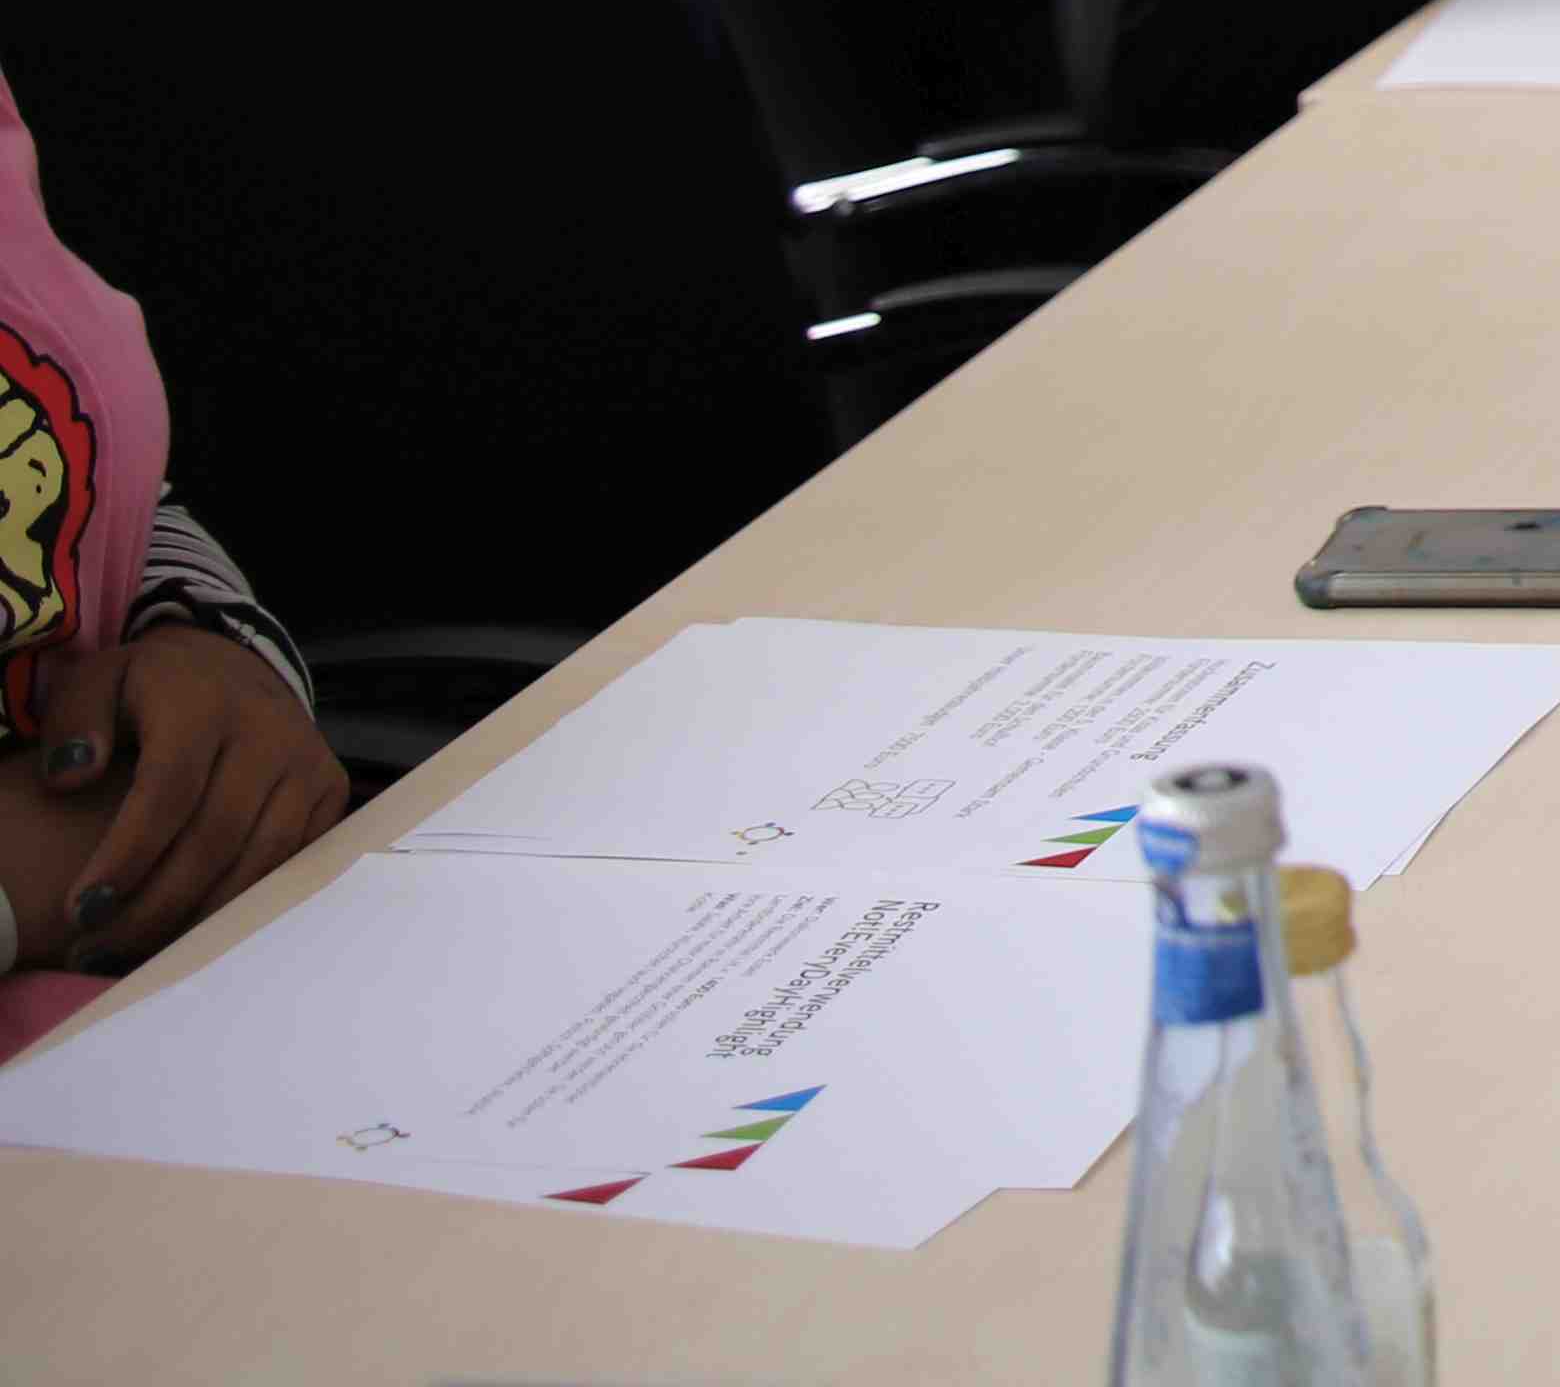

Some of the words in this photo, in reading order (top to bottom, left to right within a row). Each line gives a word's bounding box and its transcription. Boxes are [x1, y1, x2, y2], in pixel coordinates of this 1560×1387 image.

[1125, 660, 1280, 762] Zusammenfassung
[691, 898, 909, 1059] Not!EveryDayHighlight
[734, 899, 945, 1057] Restmittelverwendung
